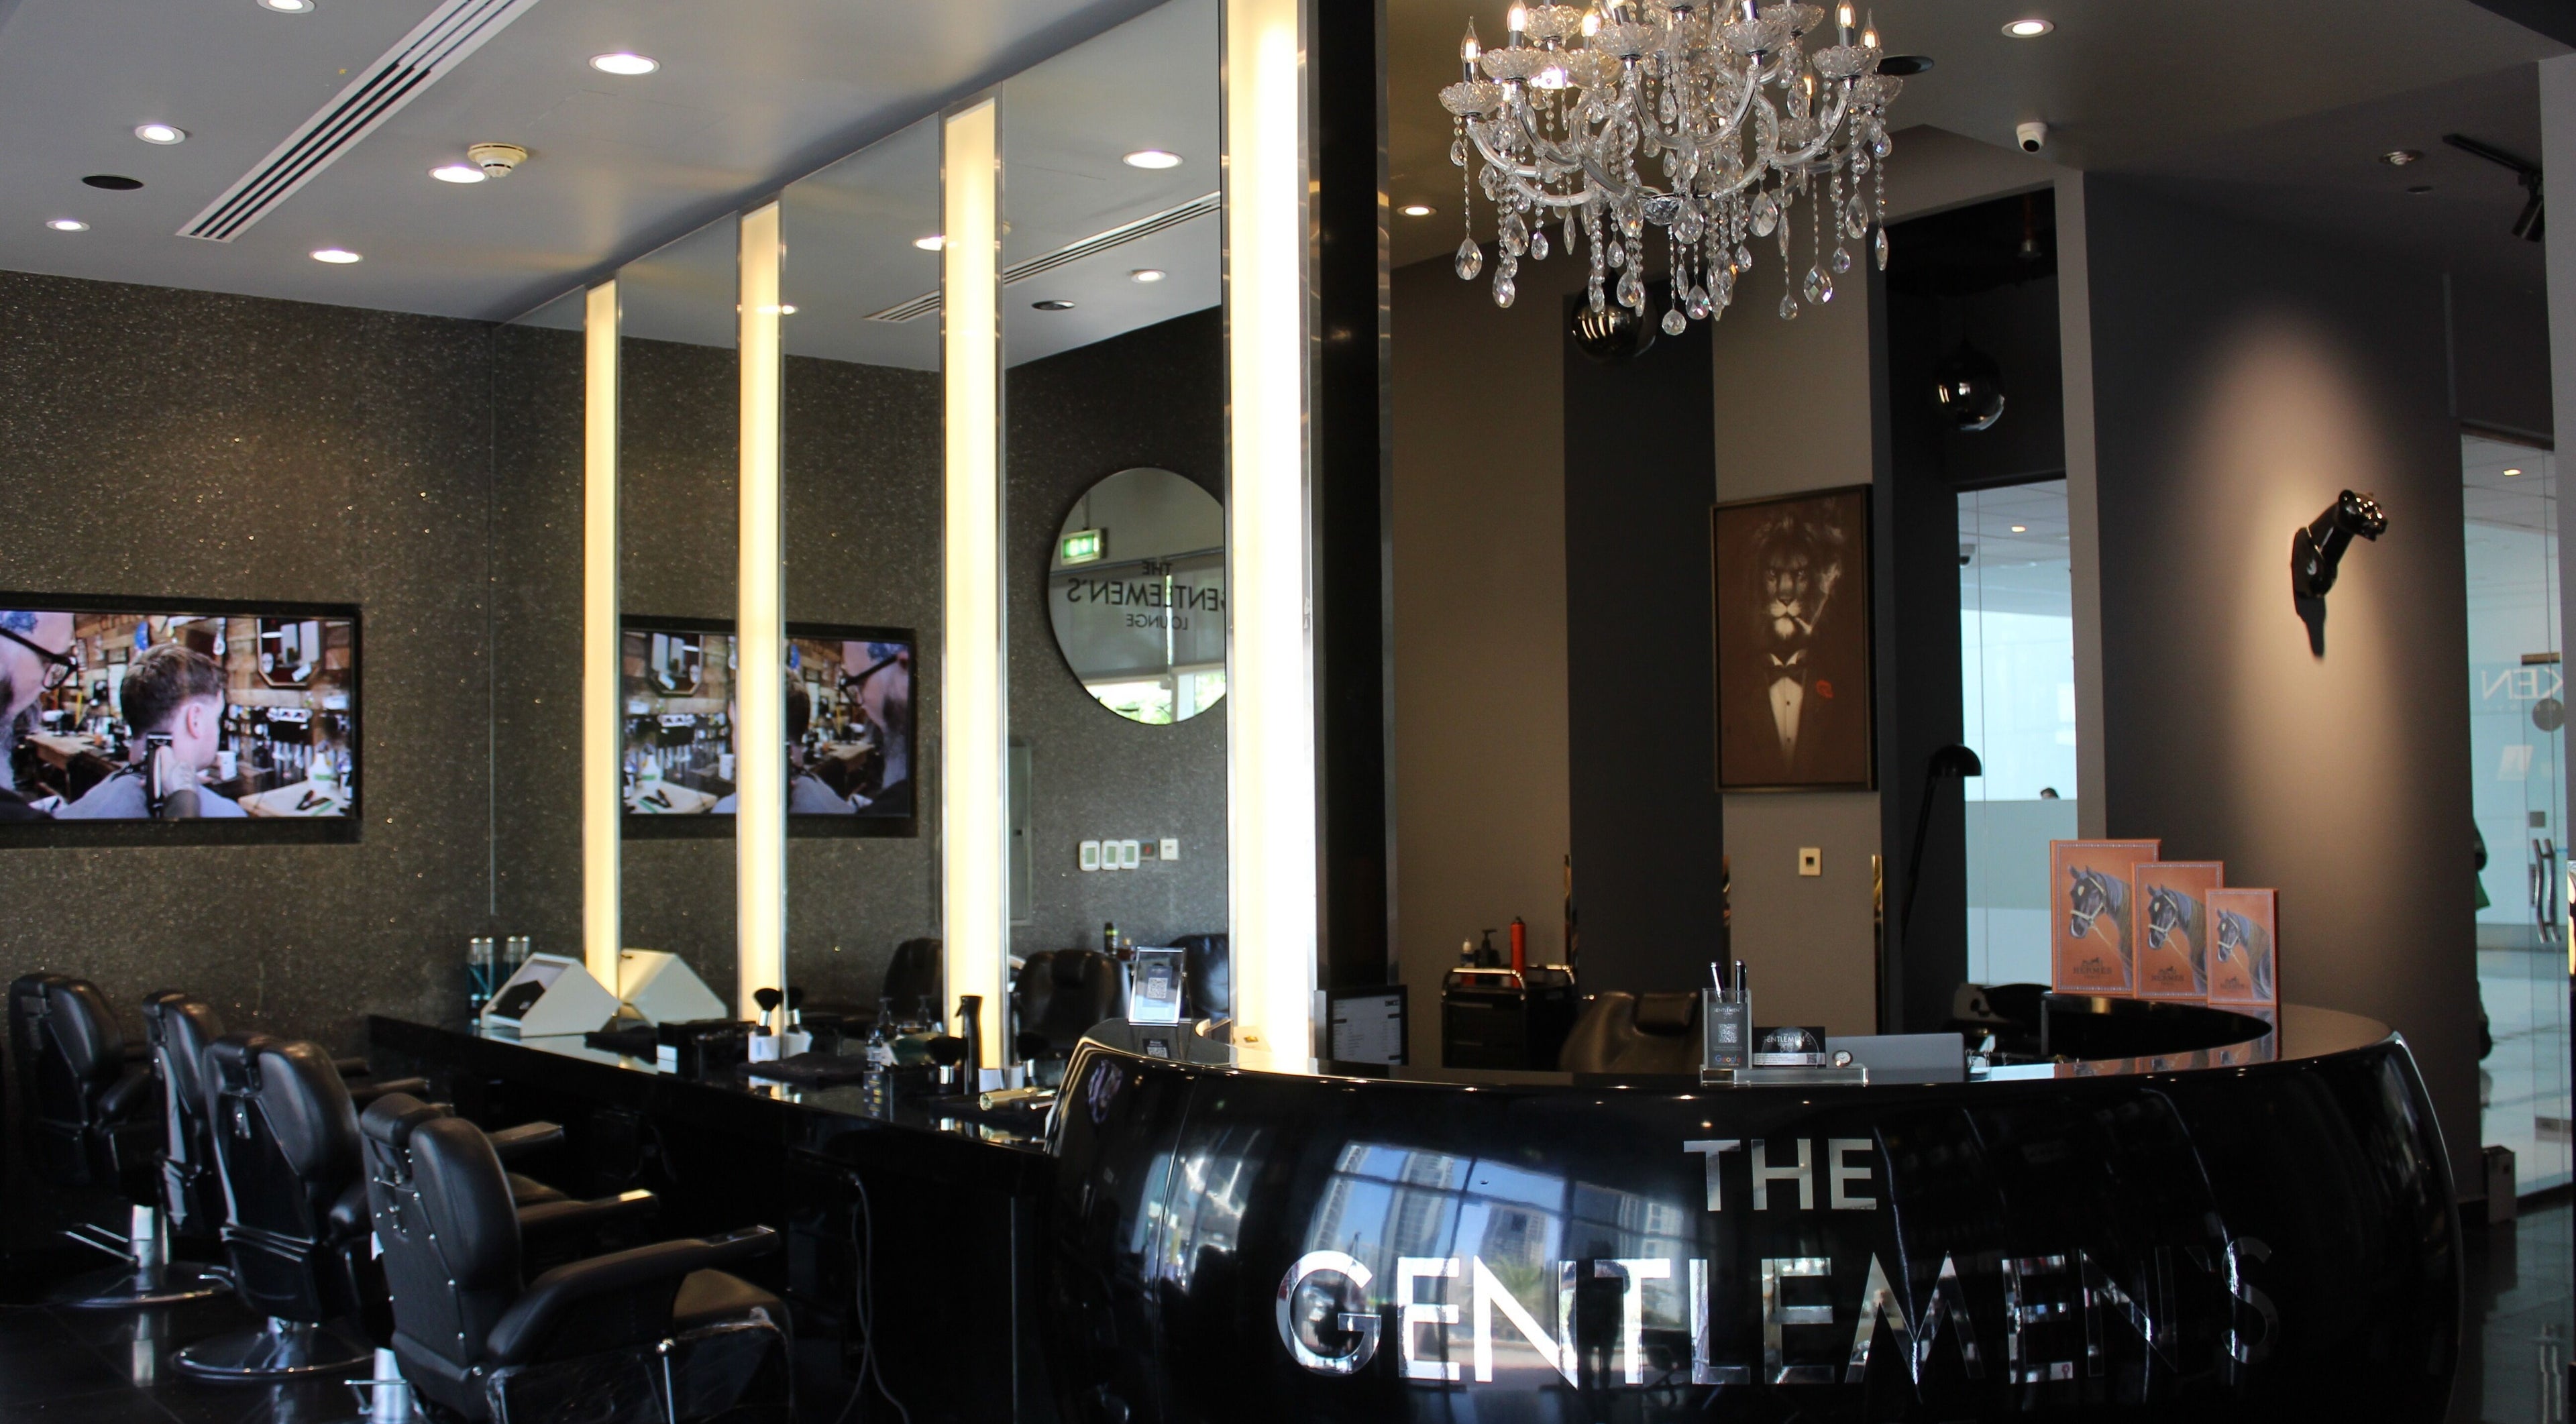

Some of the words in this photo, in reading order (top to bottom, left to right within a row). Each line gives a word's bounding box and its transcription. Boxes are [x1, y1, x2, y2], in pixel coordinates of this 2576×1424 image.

[1715, 1054, 1743, 1064] Google
[1683, 1138, 1878, 1212] THE
[1276, 1236, 2279, 1392] GENTLEMEN'S
